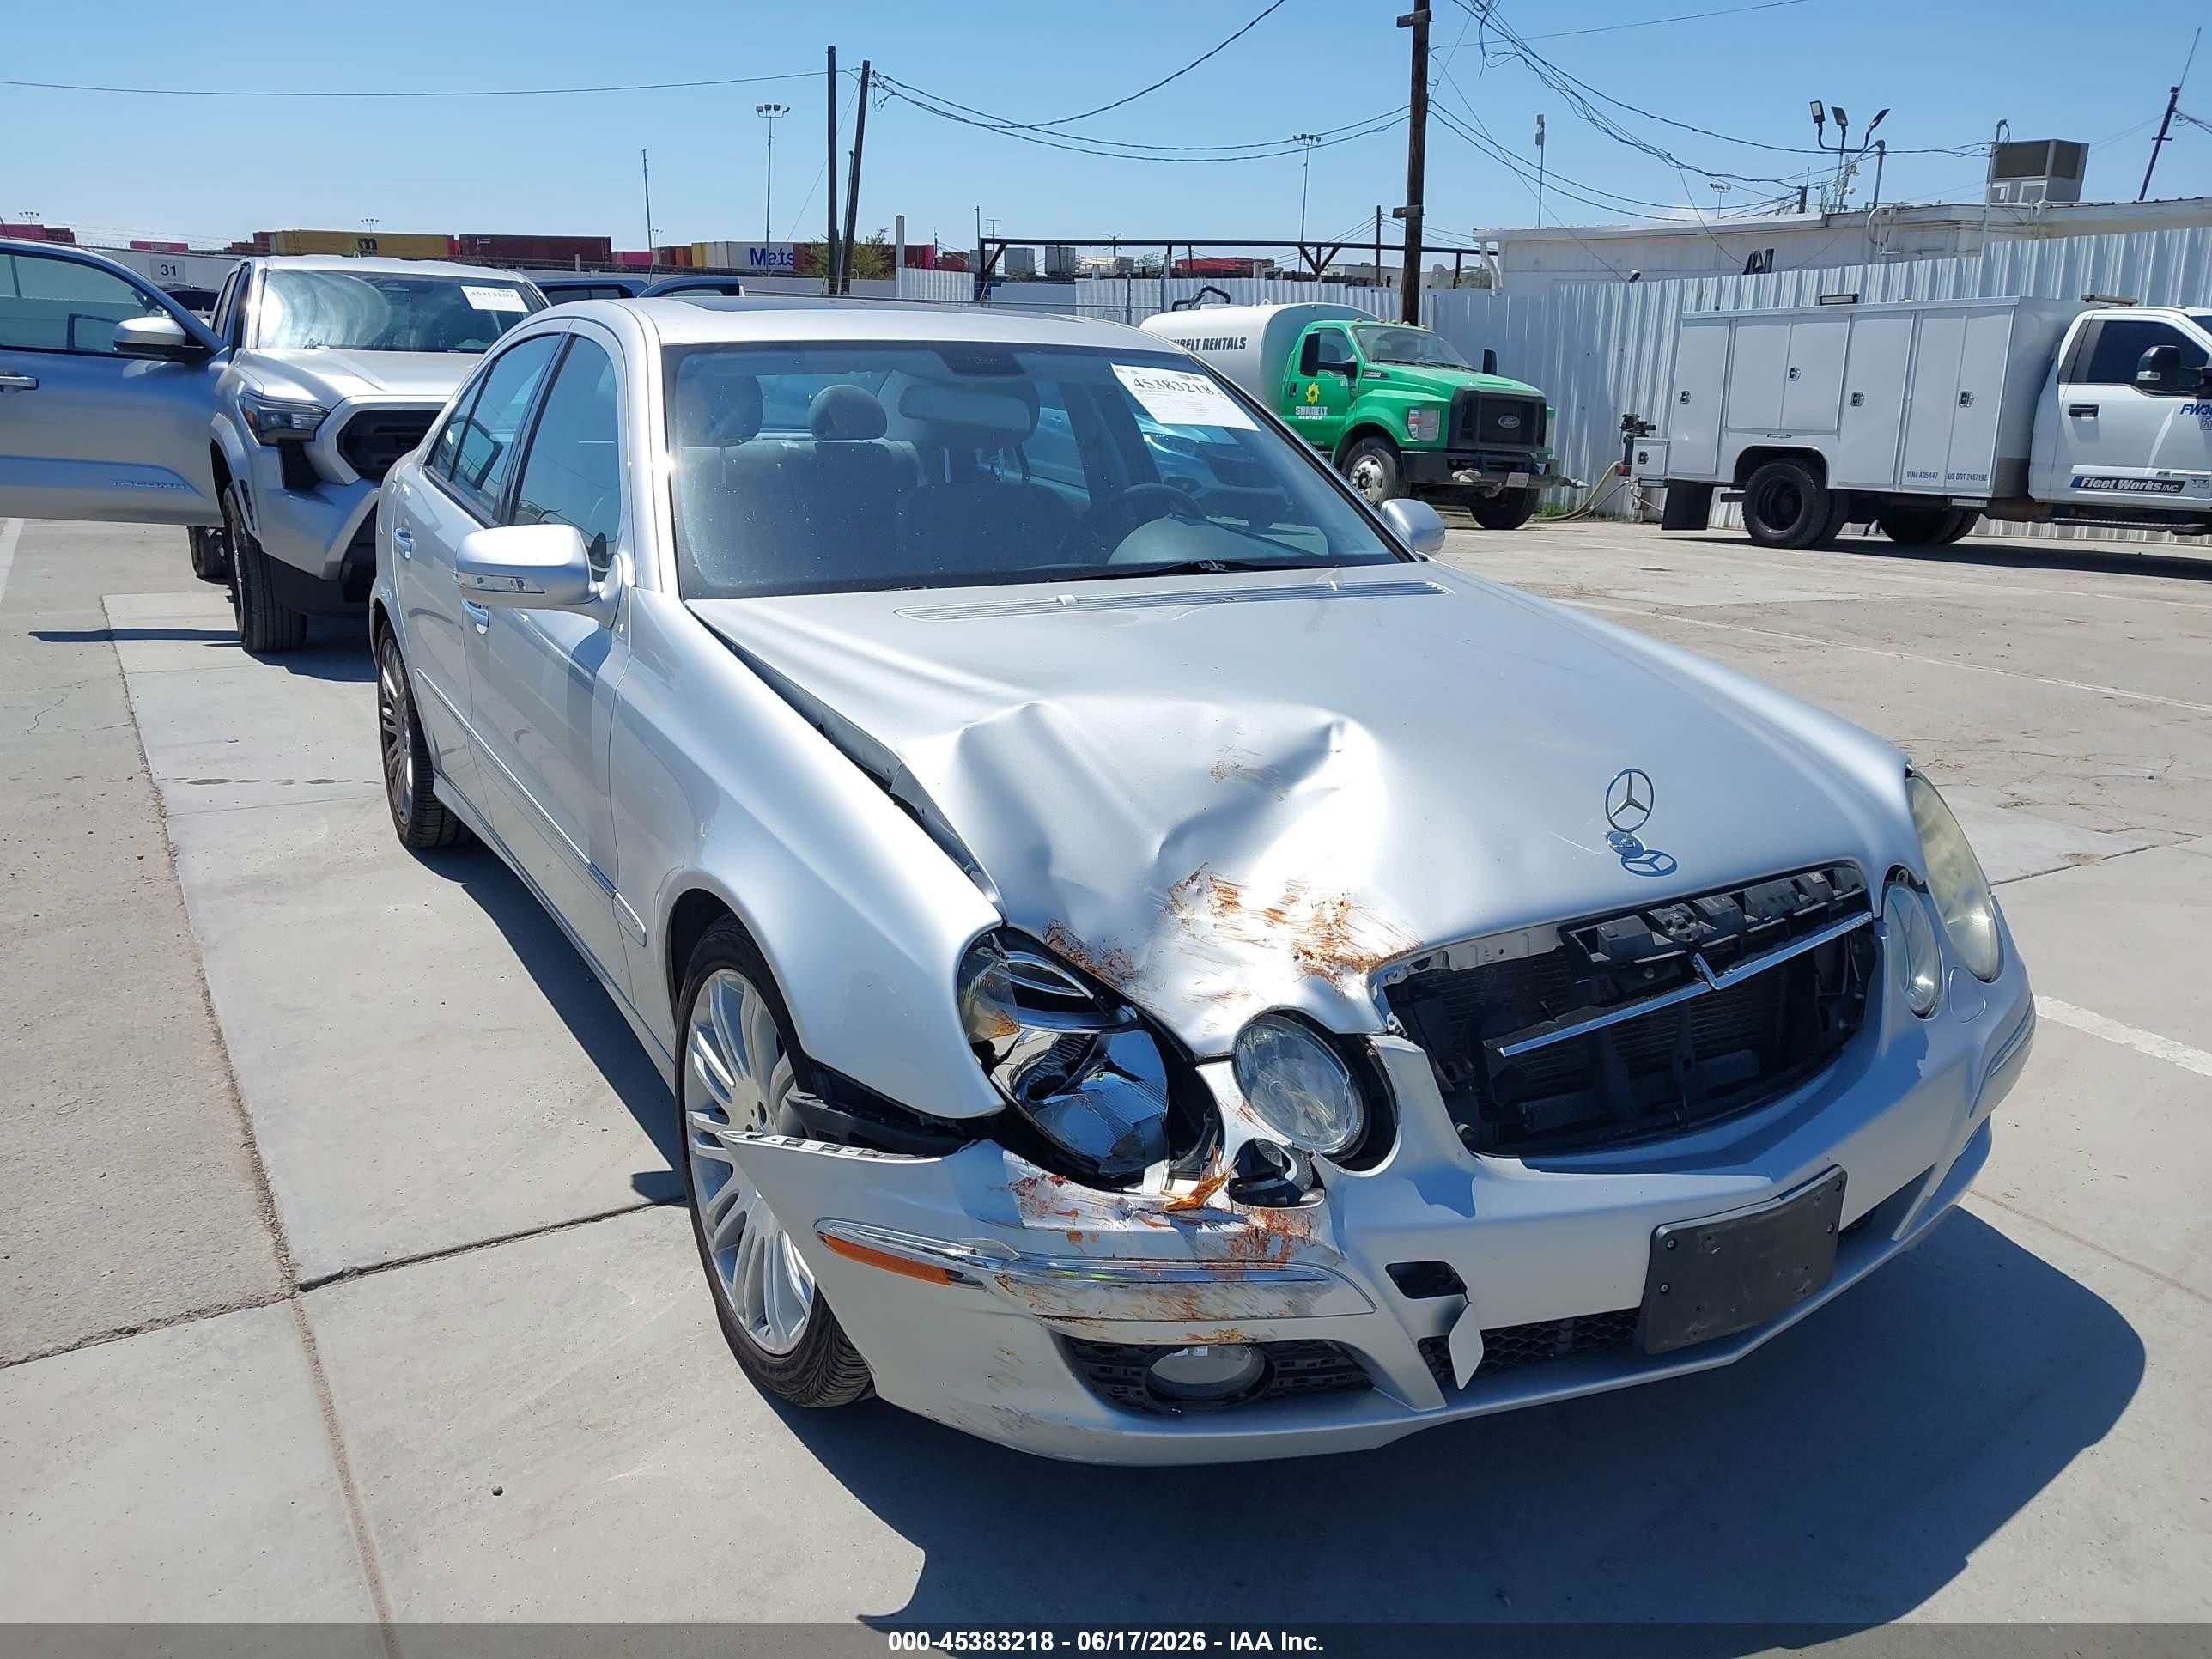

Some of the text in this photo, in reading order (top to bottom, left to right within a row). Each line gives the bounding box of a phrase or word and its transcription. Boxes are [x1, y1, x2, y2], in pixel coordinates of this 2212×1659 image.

[160, 264, 177, 276] 31
[1202, 337, 1247, 351] RENTALS
[1133, 378, 1214, 396] 45383218
[1295, 405, 1328, 416] SUNBELT
[1948, 472, 1955, 481] US
[1955, 472, 1966, 481] DOT
[110, 480, 187, 490] TACOMA
[2080, 477, 2114, 489] Fleet
[2118, 479, 2162, 491] Works
